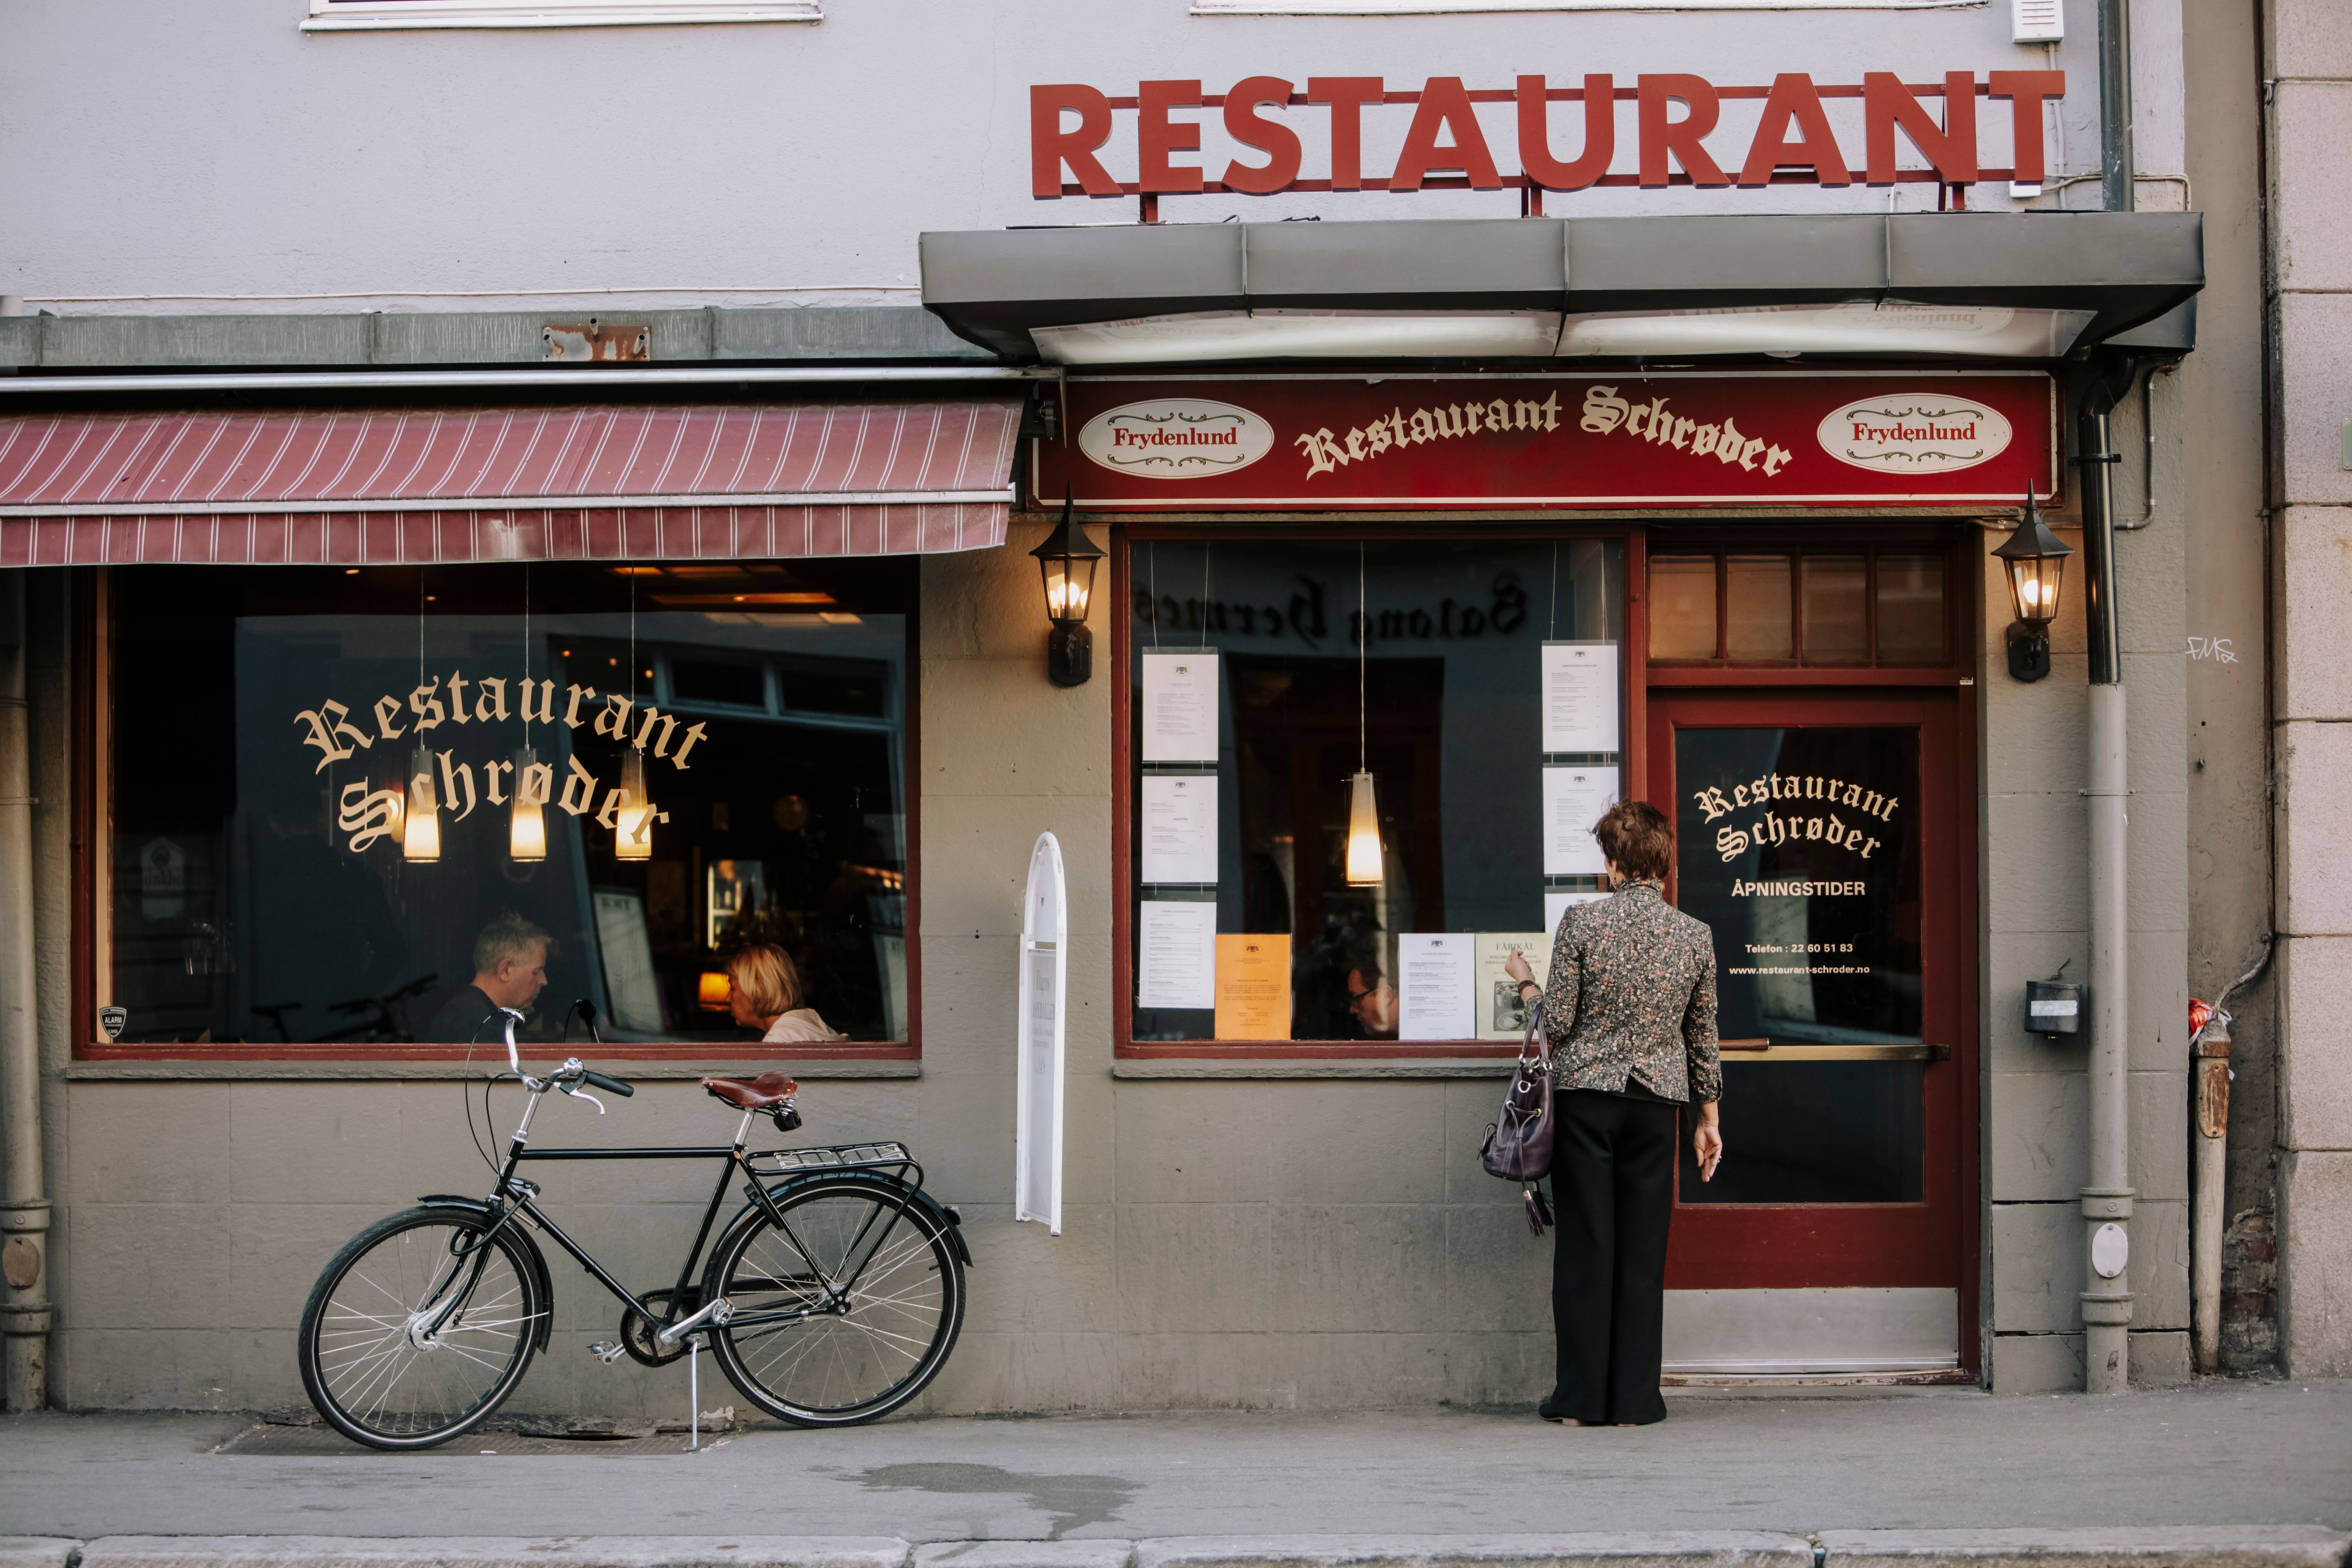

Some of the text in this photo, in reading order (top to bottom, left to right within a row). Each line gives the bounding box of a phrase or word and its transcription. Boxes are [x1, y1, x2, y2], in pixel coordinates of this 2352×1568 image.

[1031, 70, 2065, 199] RESTAURANT
[1114, 427, 1238, 449] Frydenlund
[1294, 385, 1792, 481] Restaurant Schrøder
[1852, 422, 1976, 444] Frydenlund
[294, 670, 707, 775] Restaurant
[338, 748, 669, 853] Schrøder
[1694, 772, 1899, 824] Restaurant
[1716, 811, 1880, 863] Schrøder
[1731, 879, 1866, 896] ÅPNINGSTIDER
[1729, 965, 1870, 975] www.restaurant-schroder.no
[1745, 944, 1782, 953] Telefon
[1791, 944, 1804, 953] 22
[1808, 944, 1821, 952] 60
[1824, 944, 1836, 952] 51
[1840, 944, 1853, 952] 83
